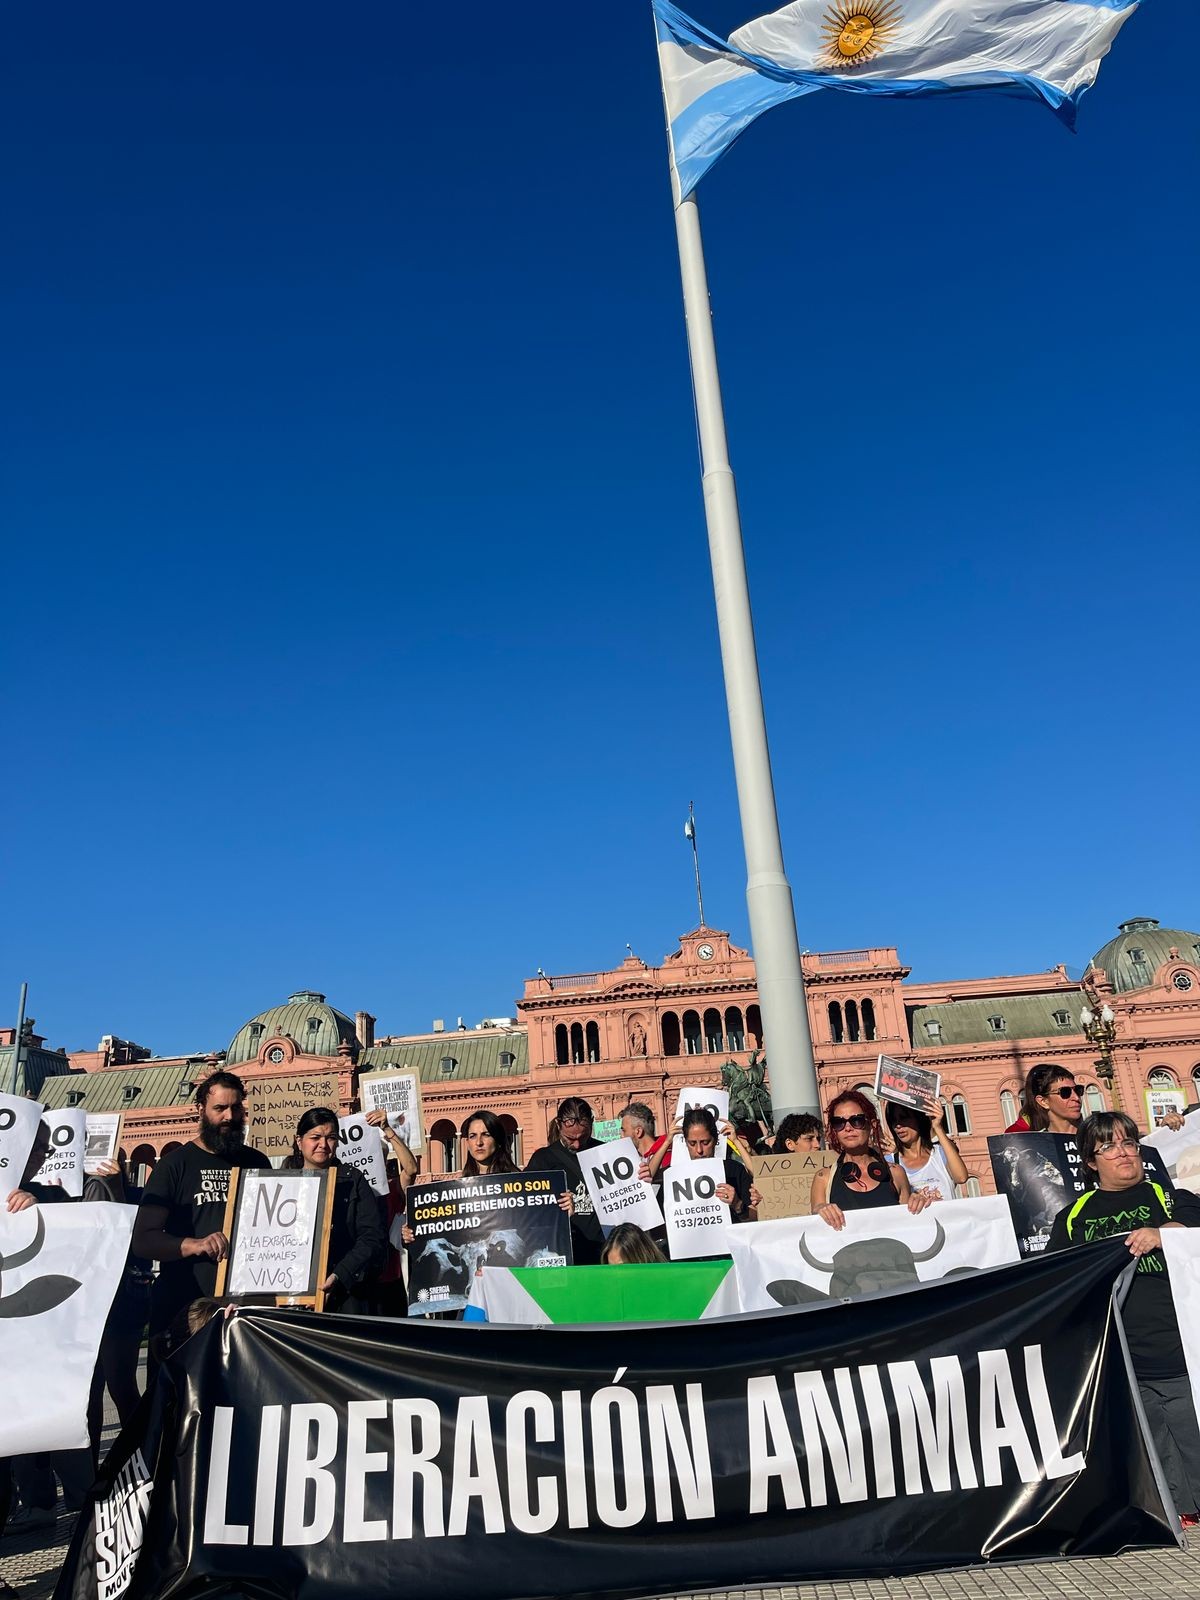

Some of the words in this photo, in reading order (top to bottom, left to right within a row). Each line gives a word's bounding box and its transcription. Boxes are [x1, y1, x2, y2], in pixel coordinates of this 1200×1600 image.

[252, 1084, 272, 1096] NO
[273, 1084, 283, 1094] A
[287, 1082, 301, 1092] LA
[881, 1072, 908, 1092] NO
[253, 1103, 266, 1112] DE
[252, 1116, 266, 1126] NO
[337, 1124, 364, 1146] NO
[348, 1146, 362, 1156] LOS
[591, 1156, 634, 1190] NO
[758, 1159, 792, 1176] NO
[600, 1193, 610, 1203] AL
[611, 1181, 643, 1199] DECRETO
[672, 1174, 716, 1203] NO
[772, 1176, 814, 1193] DECRE
[414, 1192, 439, 1208] ¡LOS
[440, 1184, 502, 1201] ANIMALES
[504, 1182, 522, 1194] NO
[525, 1180, 551, 1192] SON
[602, 1191, 647, 1215] 133/2025
[414, 1204, 457, 1221] COSAS!
[458, 1196, 525, 1214] FRENEMOS
[527, 1194, 557, 1206] ESTA
[673, 1208, 684, 1217] AL
[685, 1204, 721, 1215] DECRETO
[415, 1216, 481, 1236] ATROCIDAD
[674, 1215, 723, 1229] 133/2025
[250, 1236, 261, 1248] LA
[245, 1252, 255, 1262] DE
[202, 1366, 715, 1547] LIBERACIÓN
[746, 1344, 1087, 1514] ANIMAL
